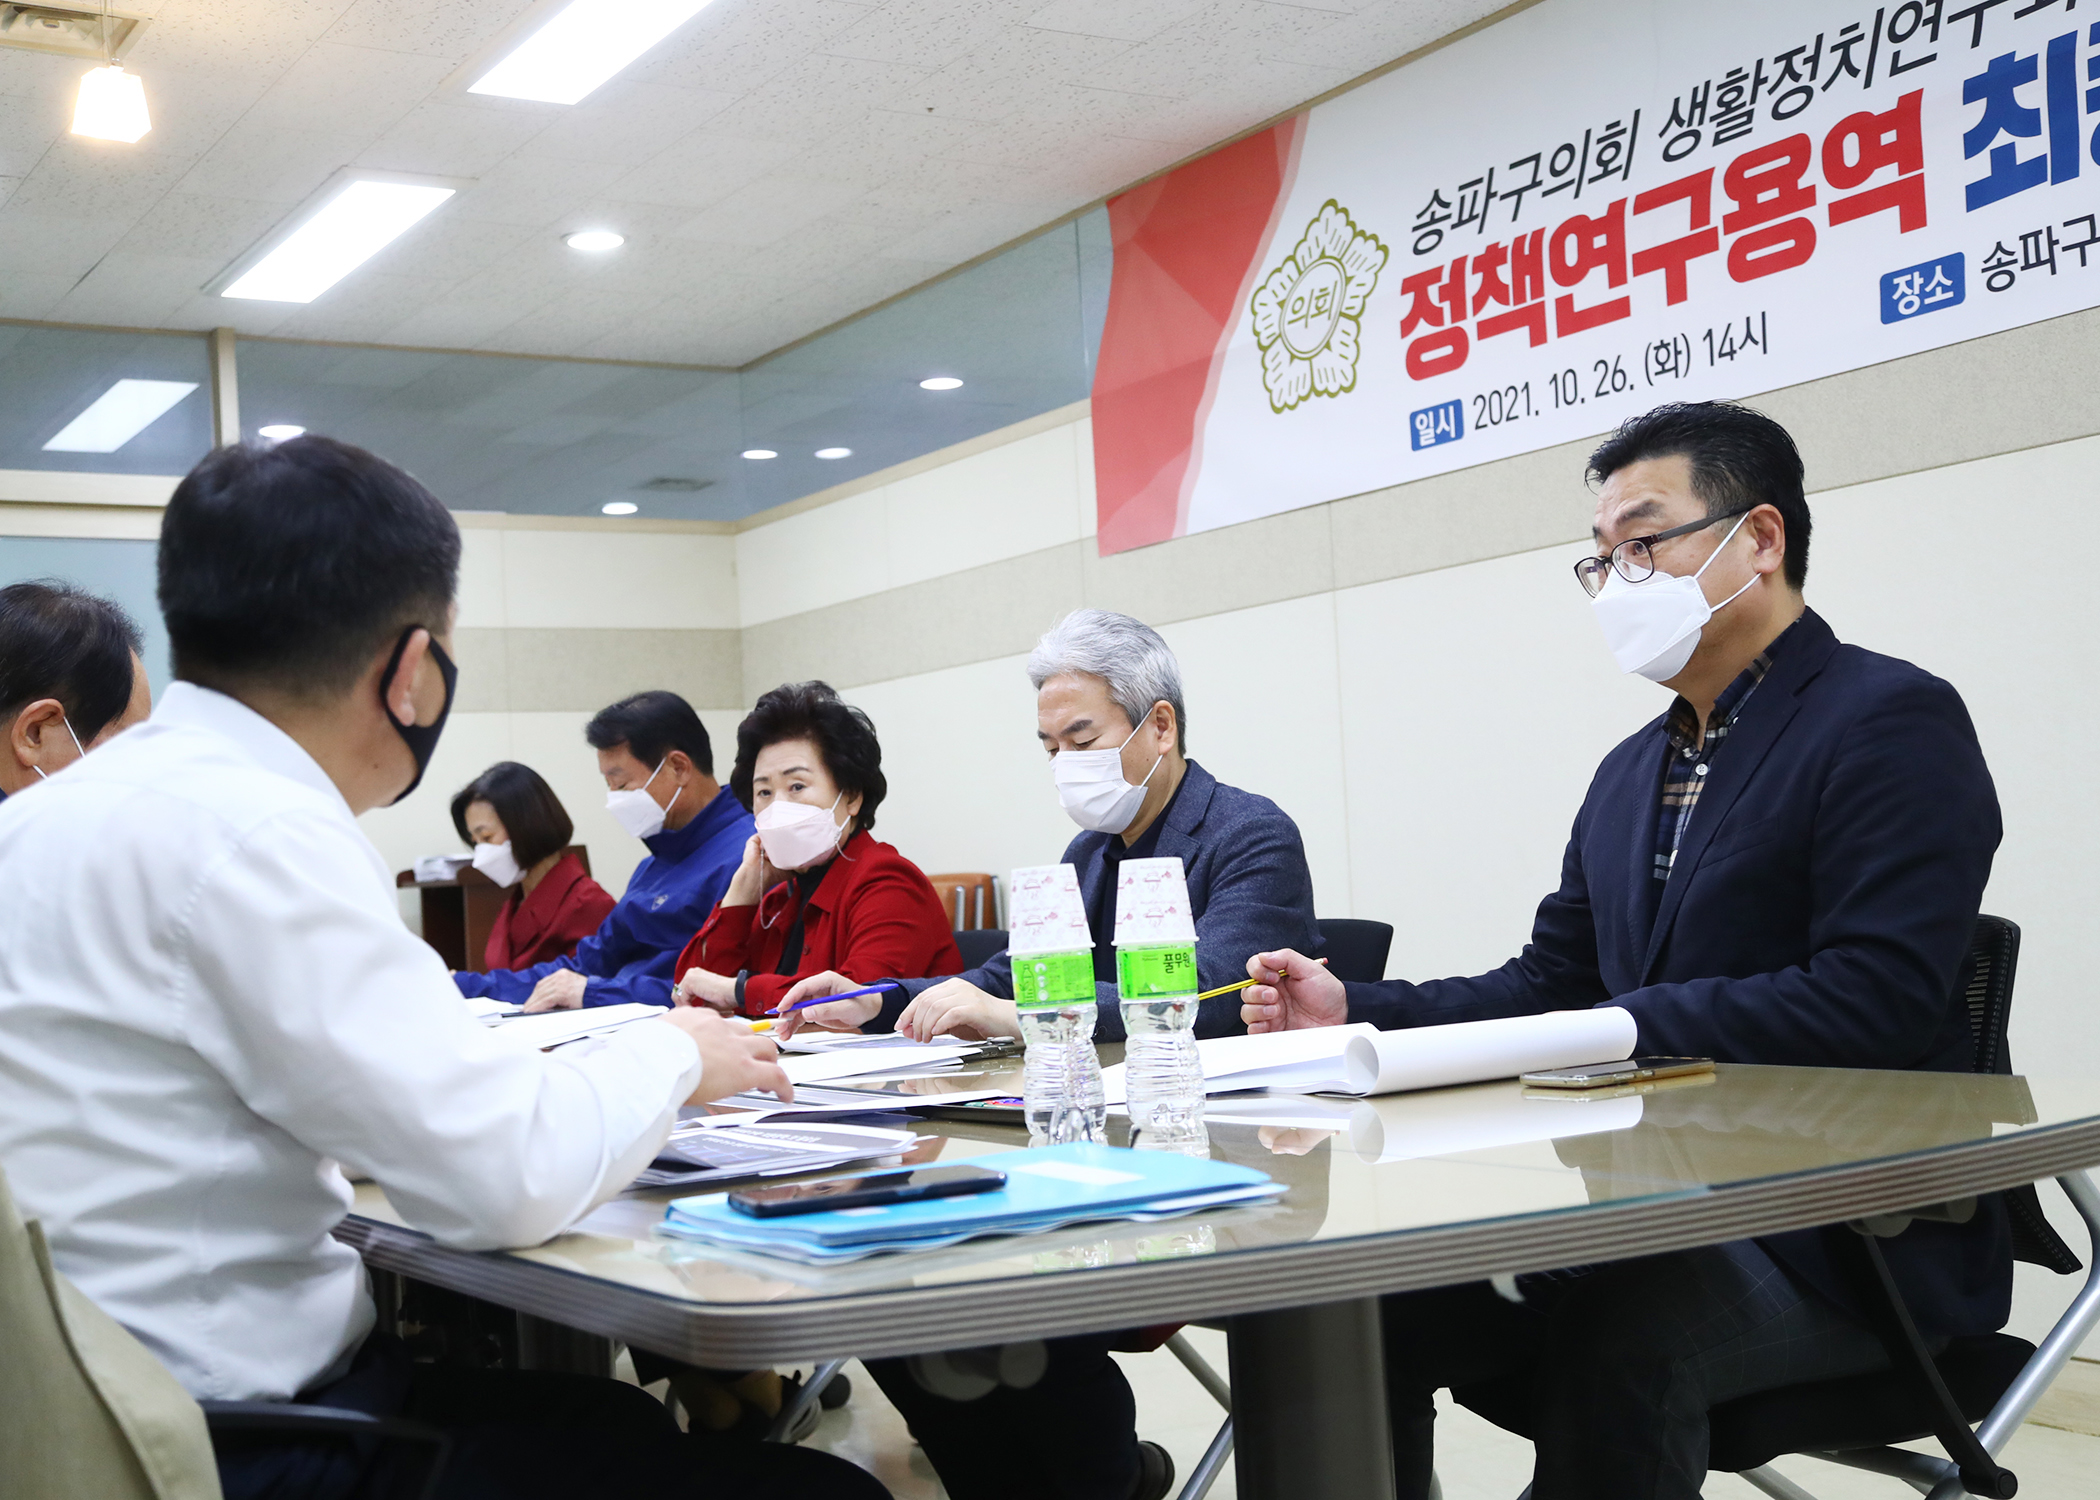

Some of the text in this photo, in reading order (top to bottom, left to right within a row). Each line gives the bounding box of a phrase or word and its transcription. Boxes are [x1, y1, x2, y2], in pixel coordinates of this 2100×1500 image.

[1411, 0, 2077, 256] 송파구의회 생활정치연
[1399, 21, 2100, 382] 정책연구용역 최
[1287, 280, 1338, 329] 의회
[1891, 213, 2100, 316] 장소 송파구
[1414, 311, 1768, 447] 일시 2021. 10. 26. (화) 14시
[1163, 952, 1191, 974] 풀무원
